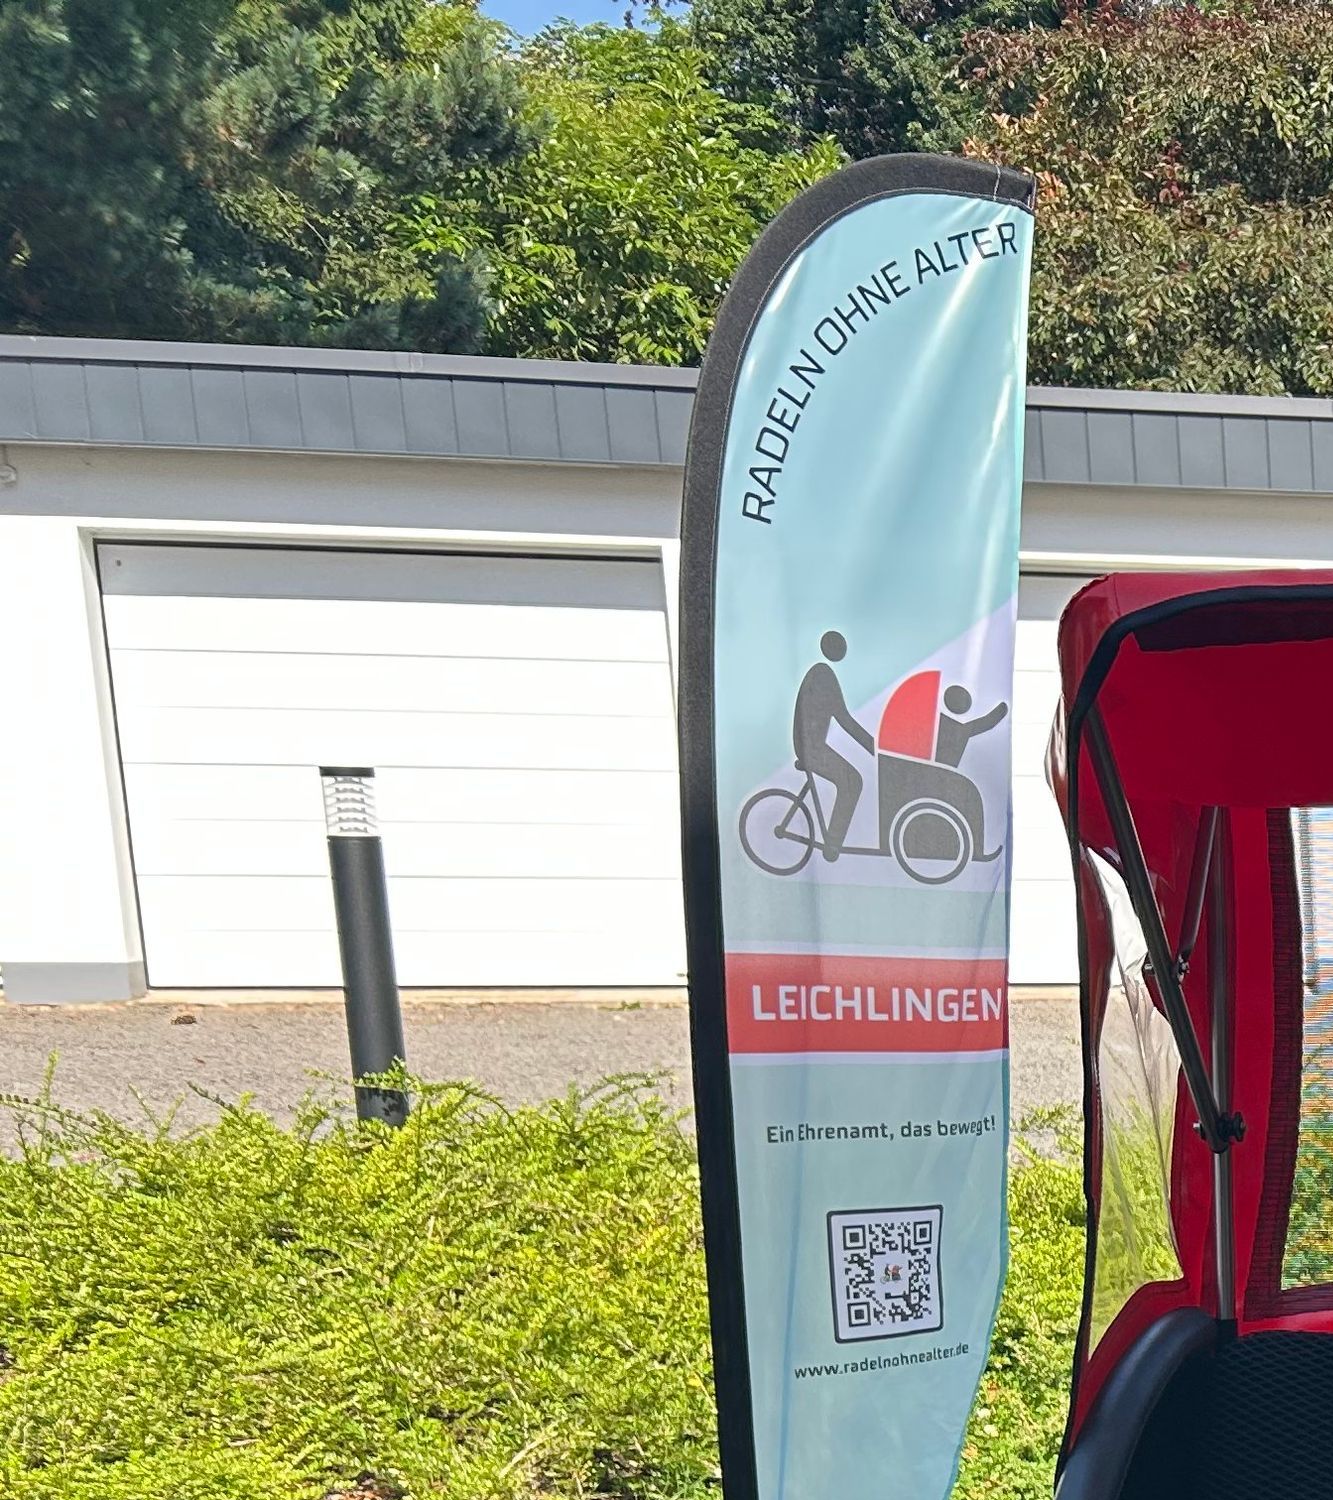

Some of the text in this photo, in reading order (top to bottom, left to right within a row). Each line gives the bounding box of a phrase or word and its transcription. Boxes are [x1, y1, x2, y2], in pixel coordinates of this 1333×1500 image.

[742, 221, 1020, 525] RADELN OHNE ALTER
[752, 984, 1002, 1023] LEICHLINGEN
[766, 1115, 996, 1144] Ein Ehrenamt, das bewegt!
[794, 1342, 970, 1379] www.radelnohnealter.de
